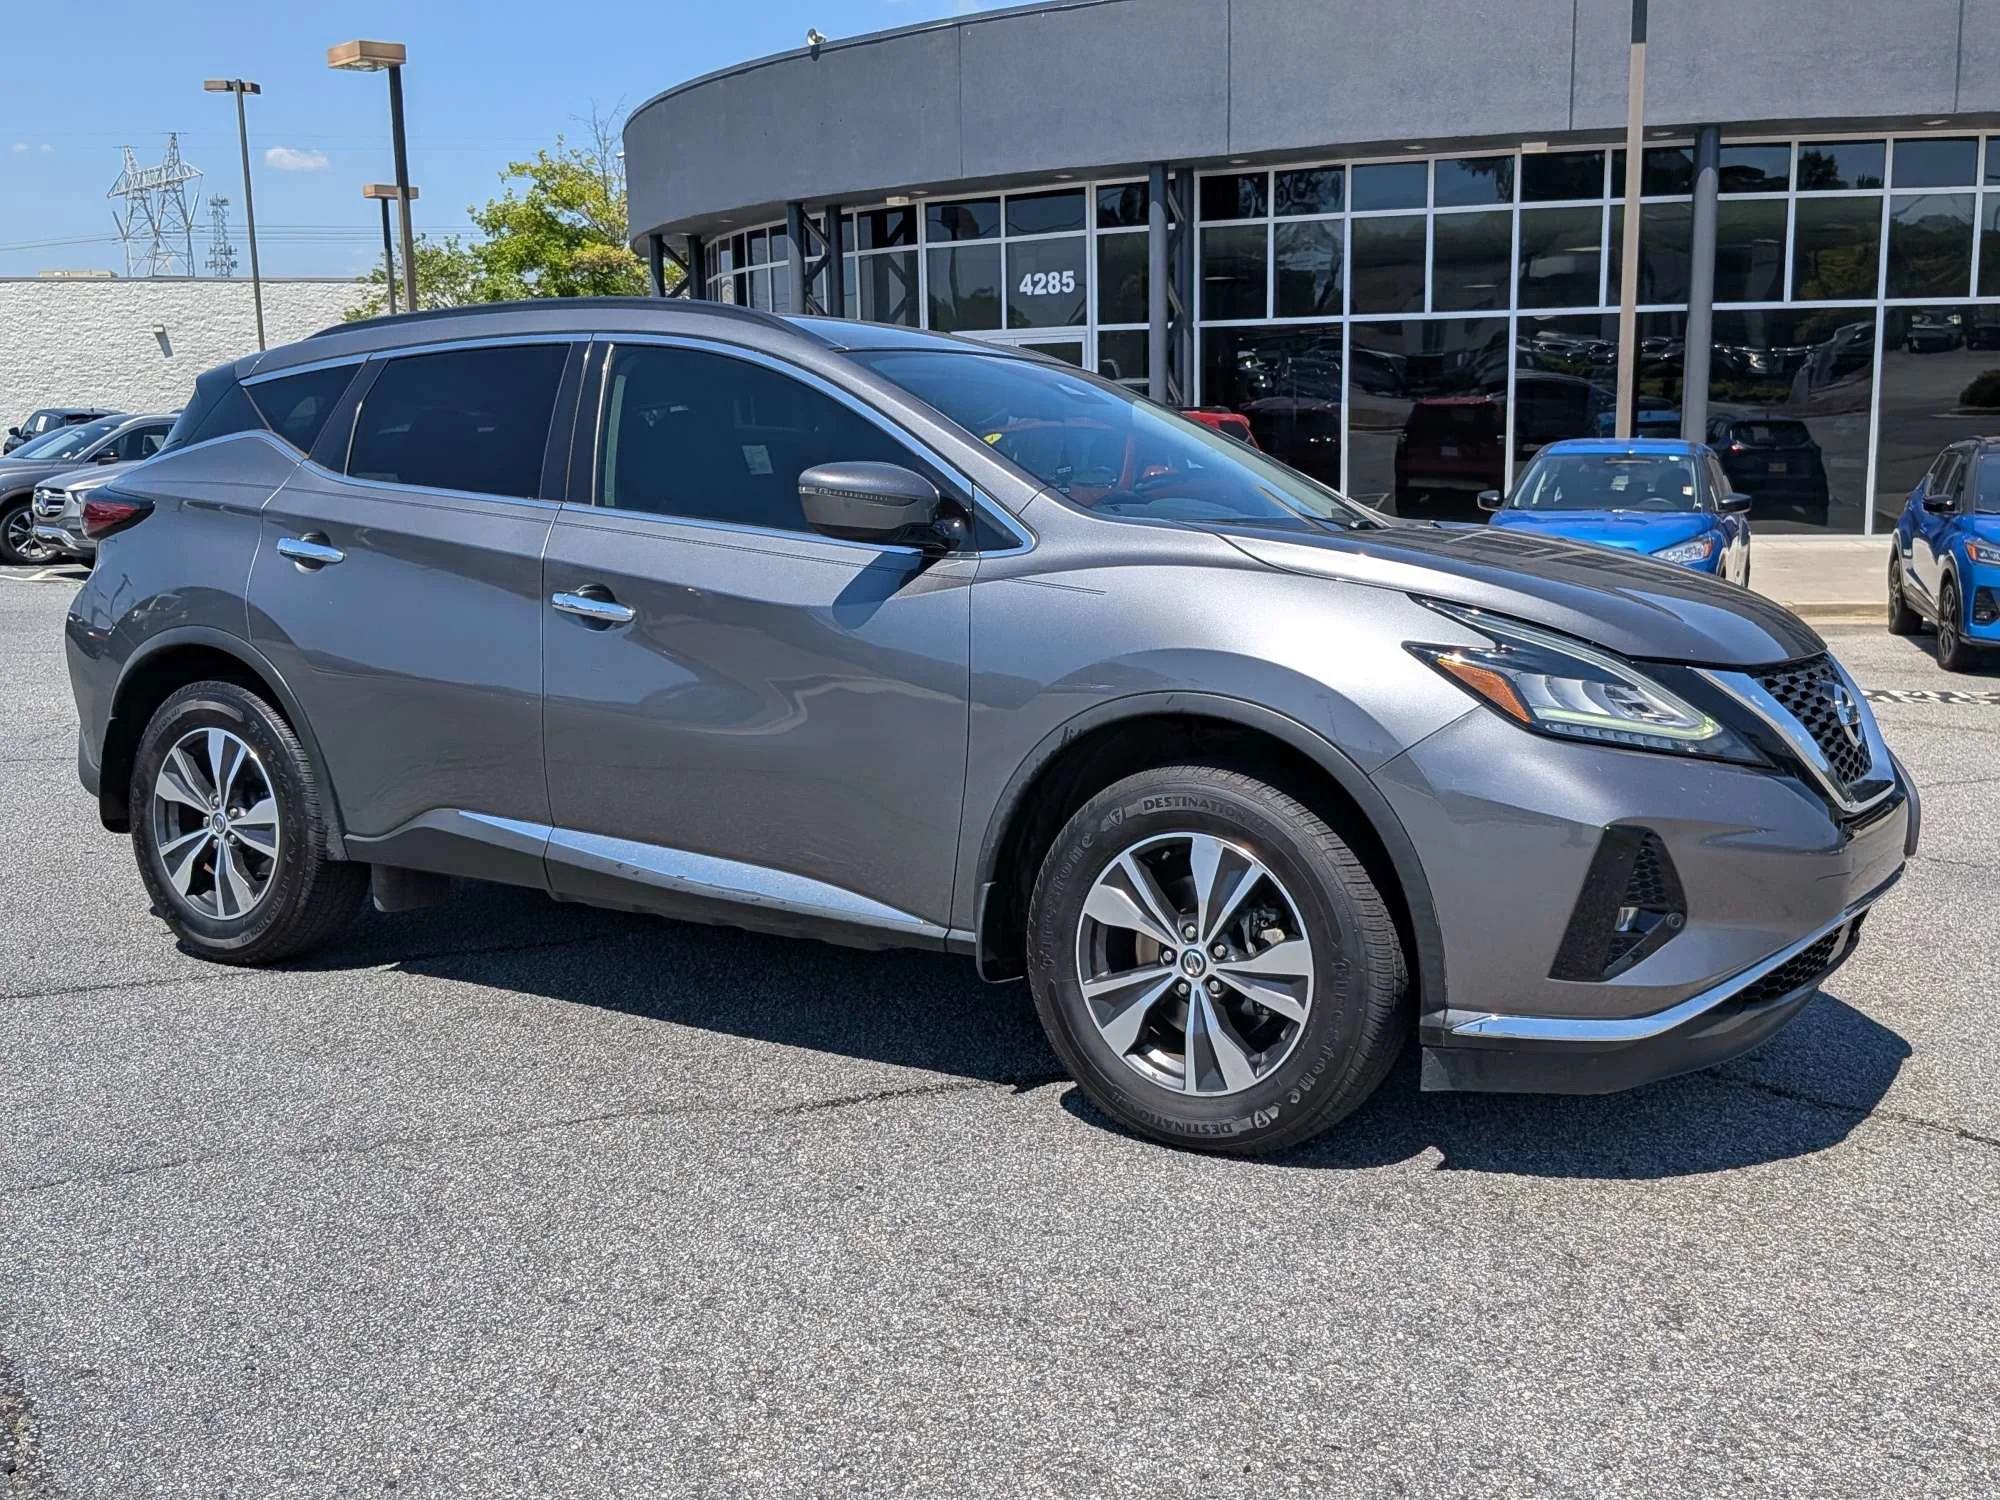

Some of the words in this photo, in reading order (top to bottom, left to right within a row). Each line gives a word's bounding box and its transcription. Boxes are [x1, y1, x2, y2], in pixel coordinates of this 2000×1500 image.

[1019, 270, 1075, 295] 4285
[1143, 796, 1249, 824] DESTINATION
[1130, 1103, 1233, 1135] DESTINATION
